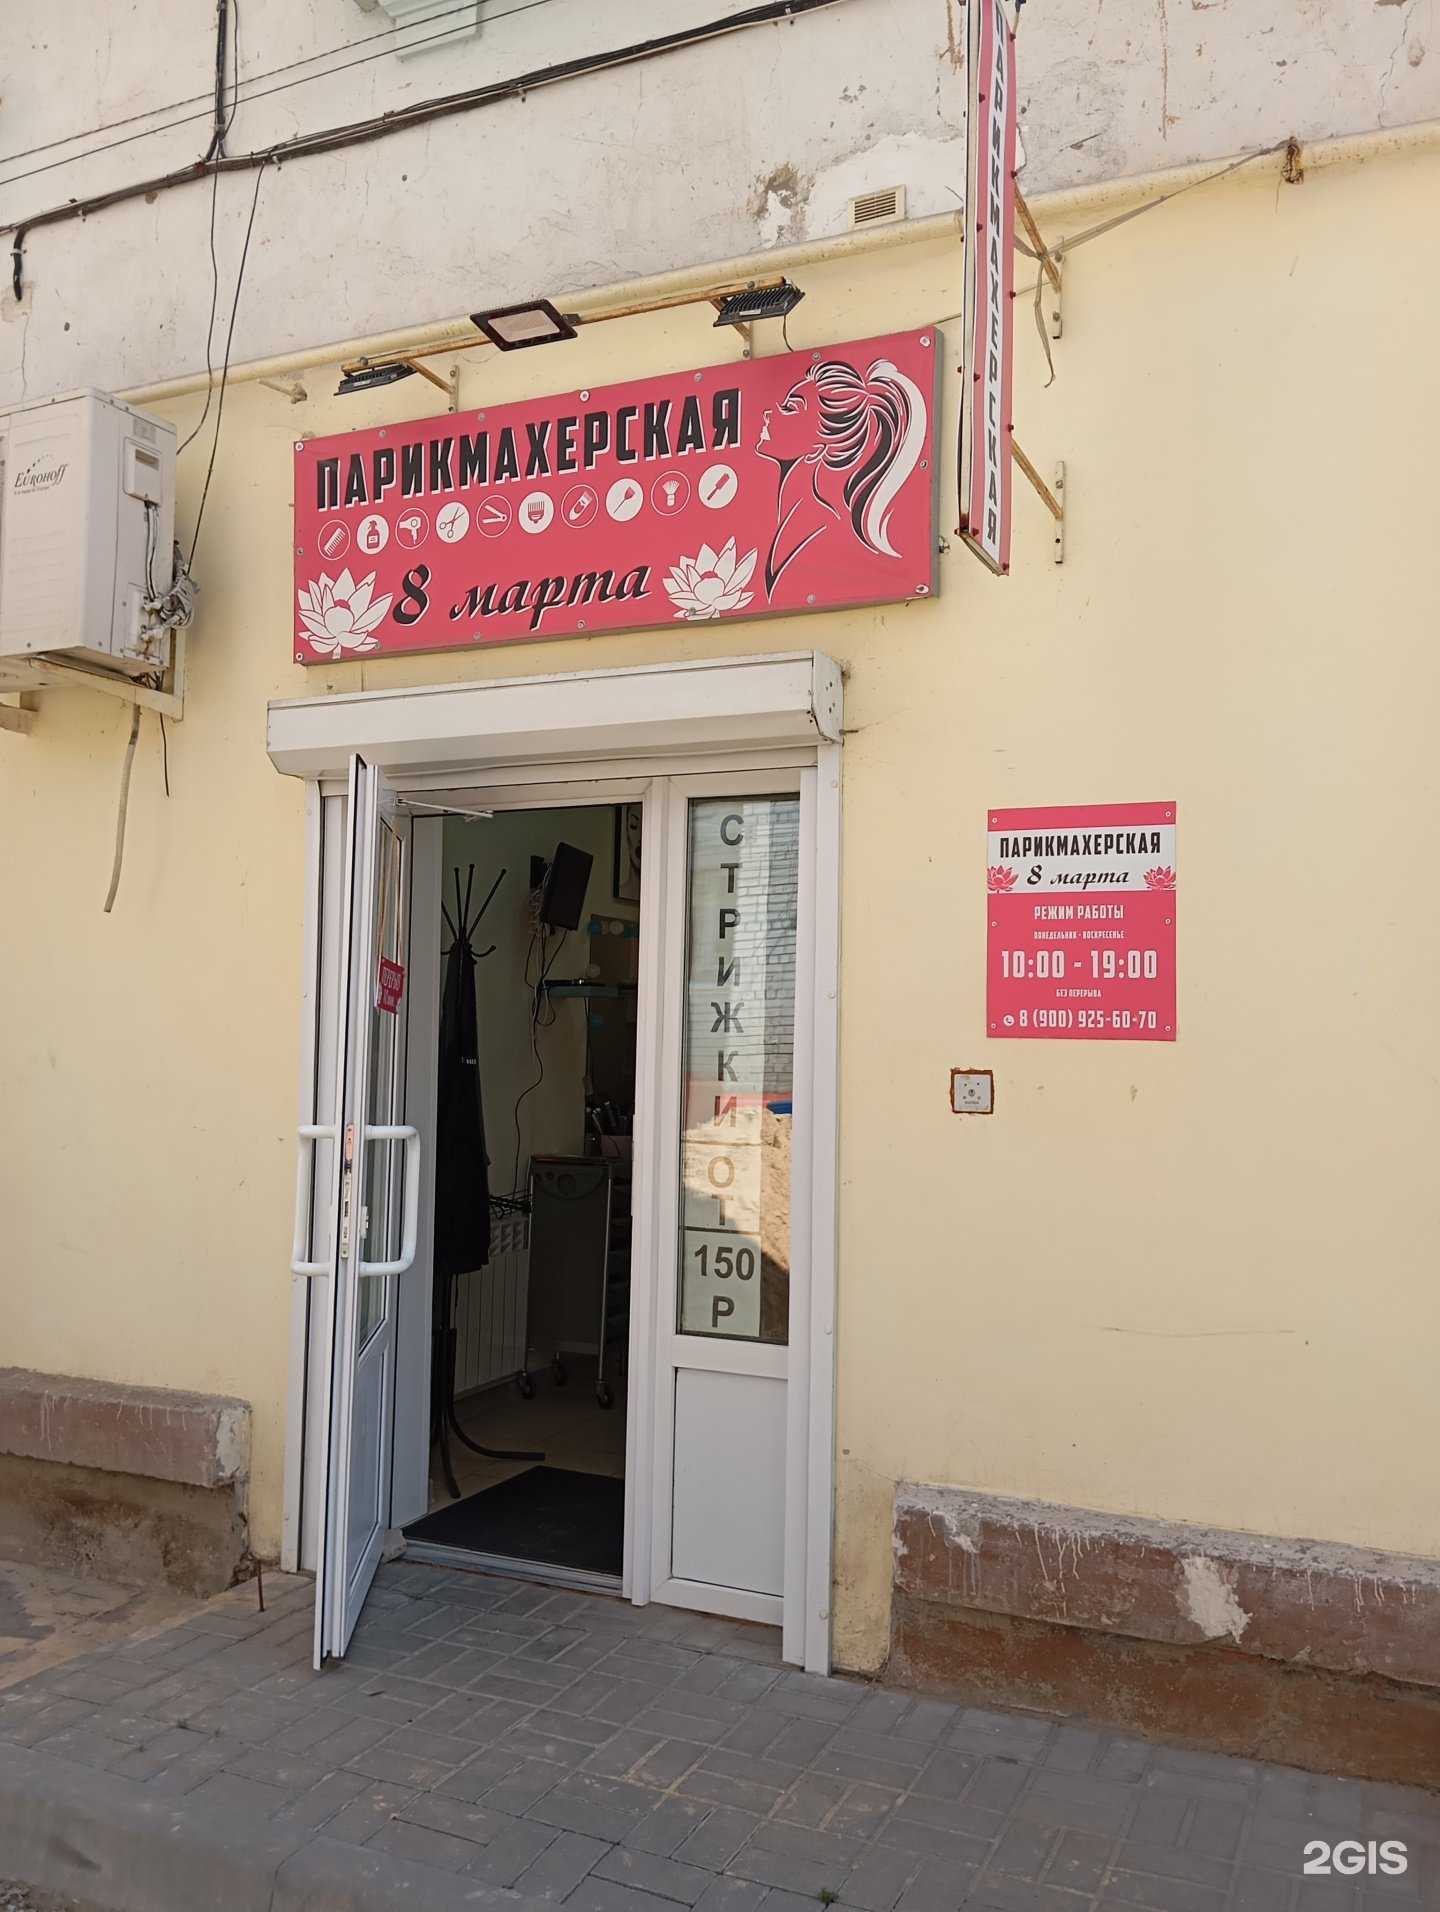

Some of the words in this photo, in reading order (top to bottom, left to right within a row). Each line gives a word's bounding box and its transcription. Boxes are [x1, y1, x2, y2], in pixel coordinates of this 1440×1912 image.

[316, 387, 743, 512] ПАРИКМАХЕРСКАЯ
[392, 563, 432, 626] 8
[449, 564, 651, 631] марта
[1000, 831, 1161, 858] ПАРИКМАХЕРСКАЯ
[1026, 864, 1043, 886] 8
[1050, 870, 1129, 890] марта
[1034, 905, 1074, 920] РЕЖИМ
[1077, 904, 1124, 919] РАБОТЫ
[1001, 950, 1065, 979] 10:00
[1090, 949, 1157, 979] 19:00
[1056, 988, 1068, 998] БЕЗ
[1068, 988, 1102, 998] ПЕРЕРЫВА
[1019, 1009, 1028, 1028] 8
[1033, 1008, 1073, 1029] (900)
[1078, 1009, 1157, 1029] 925-60-70
[694, 1244, 755, 1281] 150
[711, 1295, 735, 1328] Р
